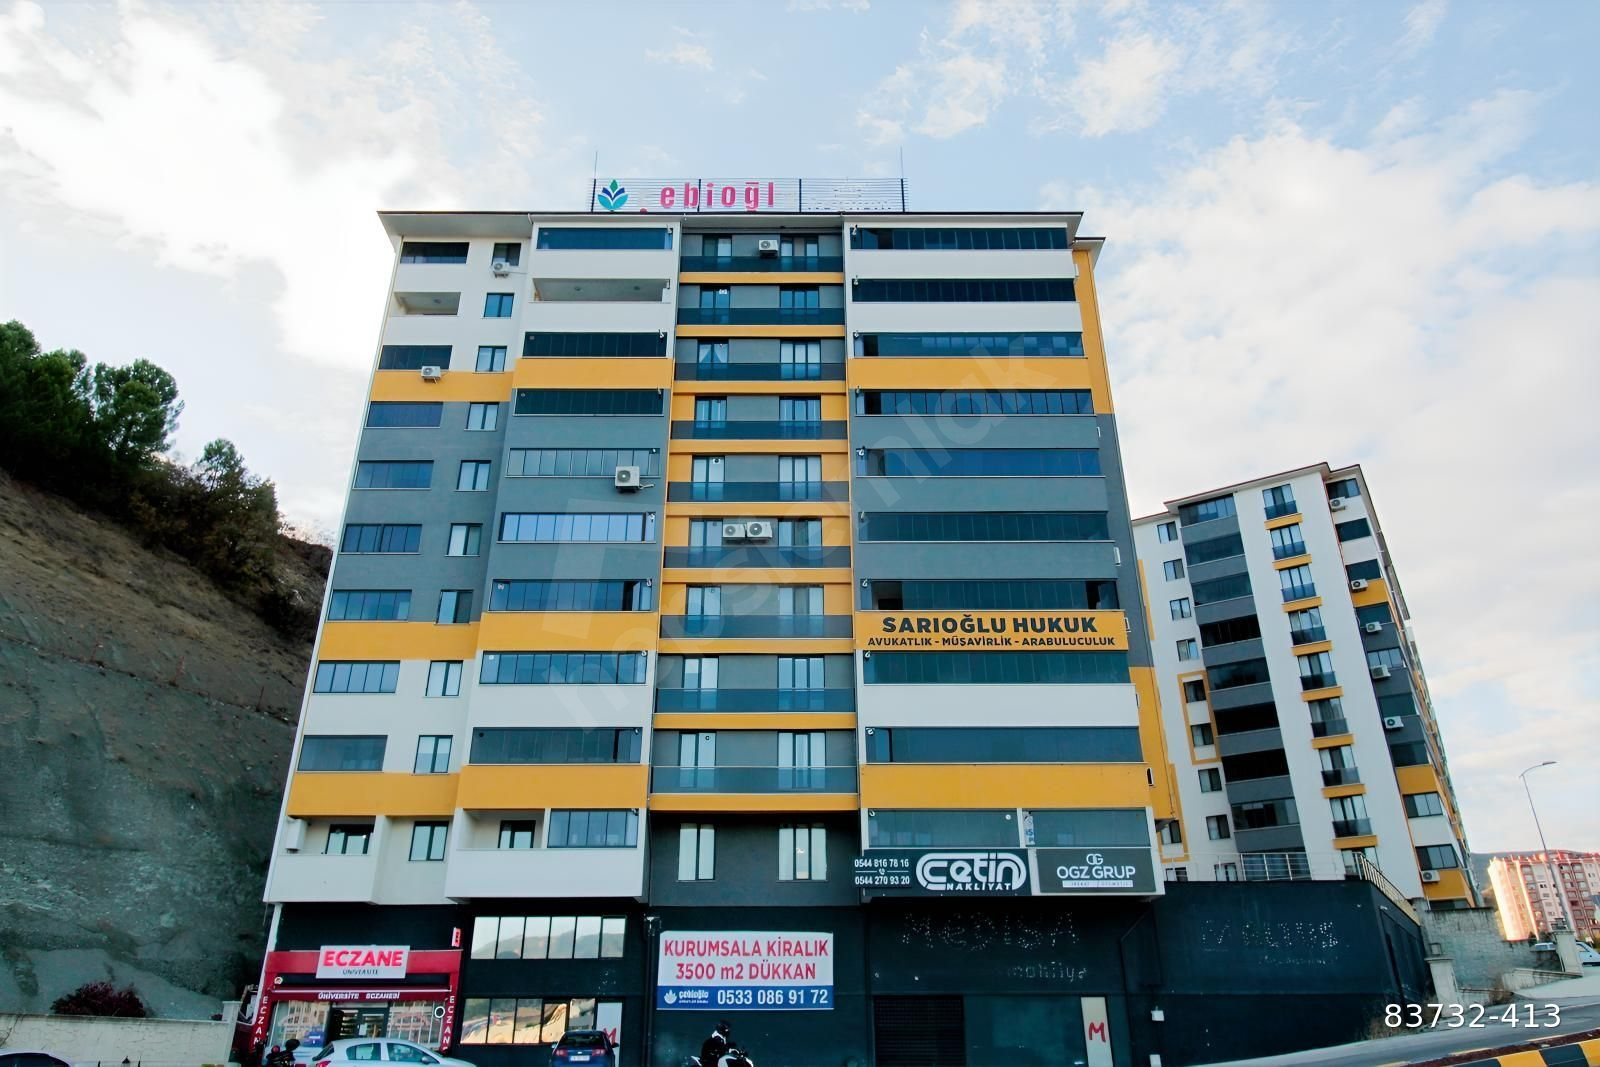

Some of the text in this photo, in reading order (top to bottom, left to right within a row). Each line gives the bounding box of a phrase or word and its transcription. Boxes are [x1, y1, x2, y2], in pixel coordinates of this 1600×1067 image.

[882, 613, 1098, 634] SARIOĞLU HUKUK
[867, 637, 932, 646] AVUKATLIK
[942, 635, 1012, 648] MÜŞAVİRLİK
[1021, 636, 1116, 647] ARABULUCULUK
[854, 859, 872, 868] 0544
[889, 859, 899, 868] 78
[874, 876, 888, 885] 270
[1056, 866, 1136, 879] OGZ GRUP
[664, 936, 829, 957] KURUMSALA KİRALIK
[323, 950, 404, 967] ECZANE
[676, 959, 816, 980] 3500 m2 DÜKKAN
[717, 989, 828, 1005] 0533 086 91 72
[1088, 1022, 1107, 1043] M
